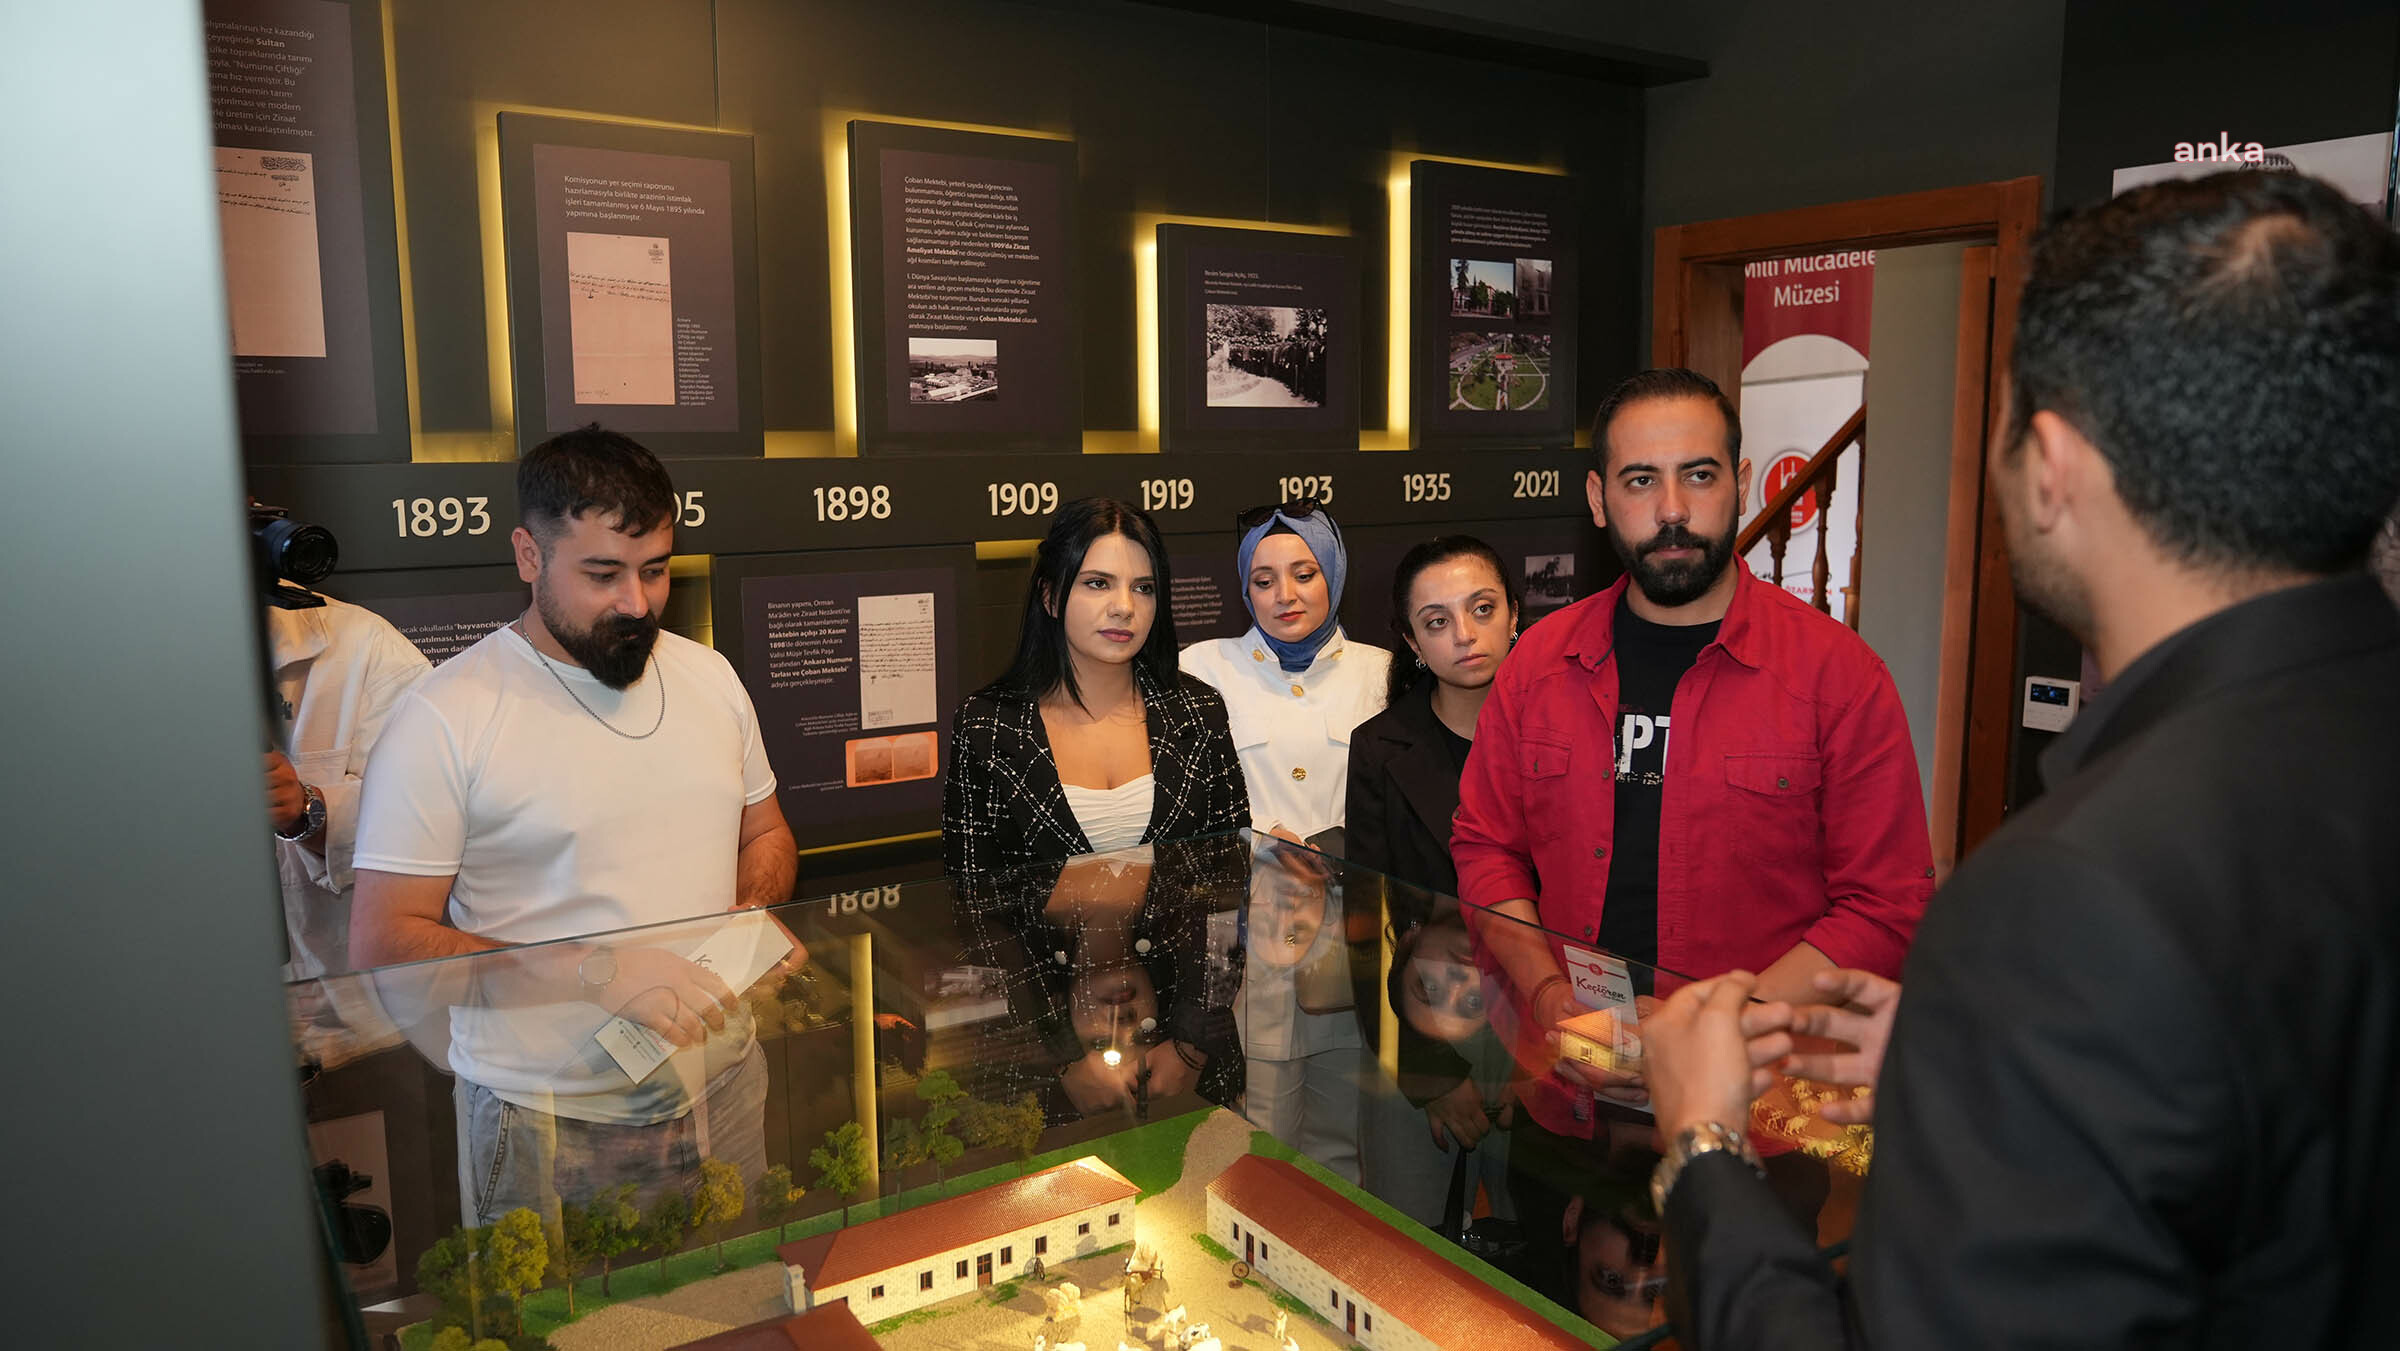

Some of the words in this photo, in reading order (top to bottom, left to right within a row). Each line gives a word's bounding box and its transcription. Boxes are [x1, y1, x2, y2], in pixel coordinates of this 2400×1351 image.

[256, 37, 285, 48] Sultan
[564, 175, 607, 186] Komisyonun
[609, 180, 619, 188] yer
[621, 181, 642, 189] seçimi
[644, 183, 674, 191] raporunu
[565, 186, 613, 198] hazırlamasıyla
[614, 190, 637, 199] birlikte
[640, 193, 665, 201] arazinin
[666, 194, 692, 203] istimlak
[565, 197, 581, 206] işleri
[583, 199, 629, 211] tamamlanmış
[646, 203, 664, 213] Mayıs
[666, 205, 682, 213] 1895
[683, 207, 705, 215] yılında
[566, 210, 598, 218] yapımına
[599, 211, 641, 221] başlanmıştır.
[1774, 280, 1840, 308] Müzesi
[979, 315, 998, 323] Çoban
[1279, 475, 1334, 504] 1923
[1402, 473, 1452, 502] 1935
[1513, 470, 1560, 499] 2021
[988, 482, 1059, 517] 1909
[1140, 478, 1195, 511] 1919
[813, 485, 892, 522] 1898
[391, 496, 492, 538] 1893
[419, 624, 454, 632] okullarda
[769, 631, 799, 639] Mektebin
[456, 633, 481, 641] kaliteli
[423, 646, 449, 654] tohum
[801, 669, 821, 677] Çoban
[1576, 976, 1626, 1000] Keçiören
